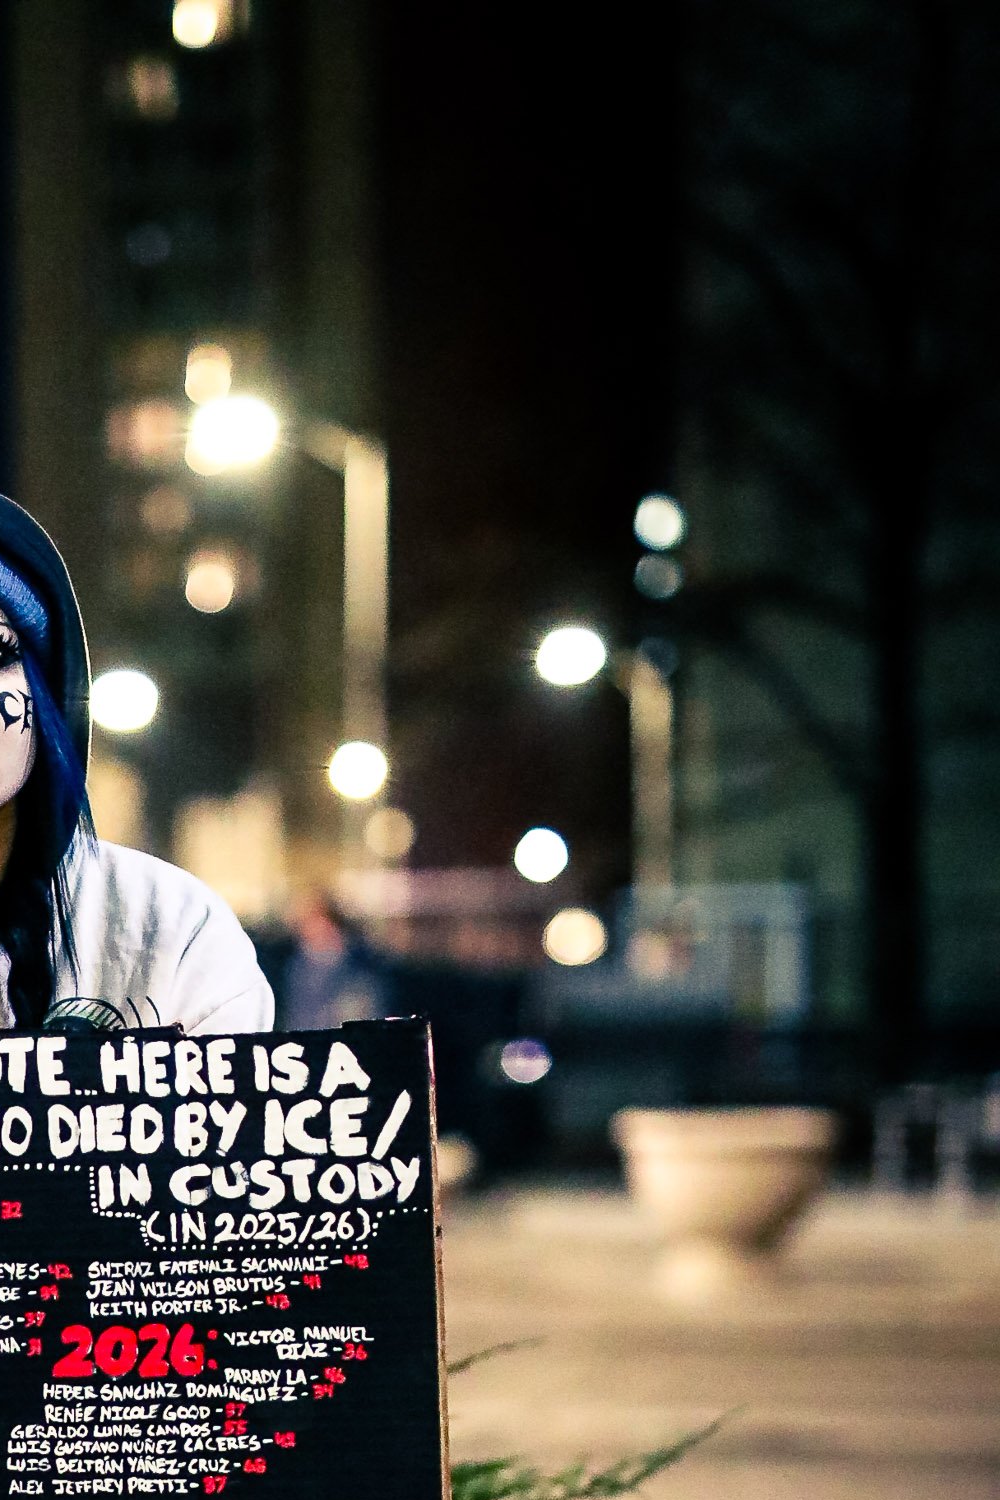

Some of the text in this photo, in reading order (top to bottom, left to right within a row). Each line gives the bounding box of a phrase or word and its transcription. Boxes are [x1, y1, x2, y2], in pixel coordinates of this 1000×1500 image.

[253, 1042, 309, 1094] IS
[319, 1042, 371, 1097] A
[48, 1104, 164, 1159] DIED
[174, 1100, 247, 1157] BY
[98, 1157, 420, 1211] IN CUSTODY
[88, 1261, 154, 1278] SHIRAZ
[86, 1276, 285, 1299] JEAN WILSON BRUTUS
[90, 1301, 147, 1318] KEITH
[152, 1299, 213, 1316] PORTER
[224, 1326, 374, 1346] VICTOR MANUEL
[276, 1342, 328, 1360] DIAZ
[224, 1368, 281, 1392] PARADY
[100, 1404, 160, 1422] NICOLE
[163, 1405, 210, 1421] GOOD
[11, 1424, 88, 1439] GERALDO
[94, 1424, 142, 1437] LUNAS
[8, 1440, 50, 1454] LUIS
[54, 1440, 119, 1456] GUSTAVO
[7, 1457, 51, 1471] LUIS
[9, 1480, 43, 1494] ALEX
